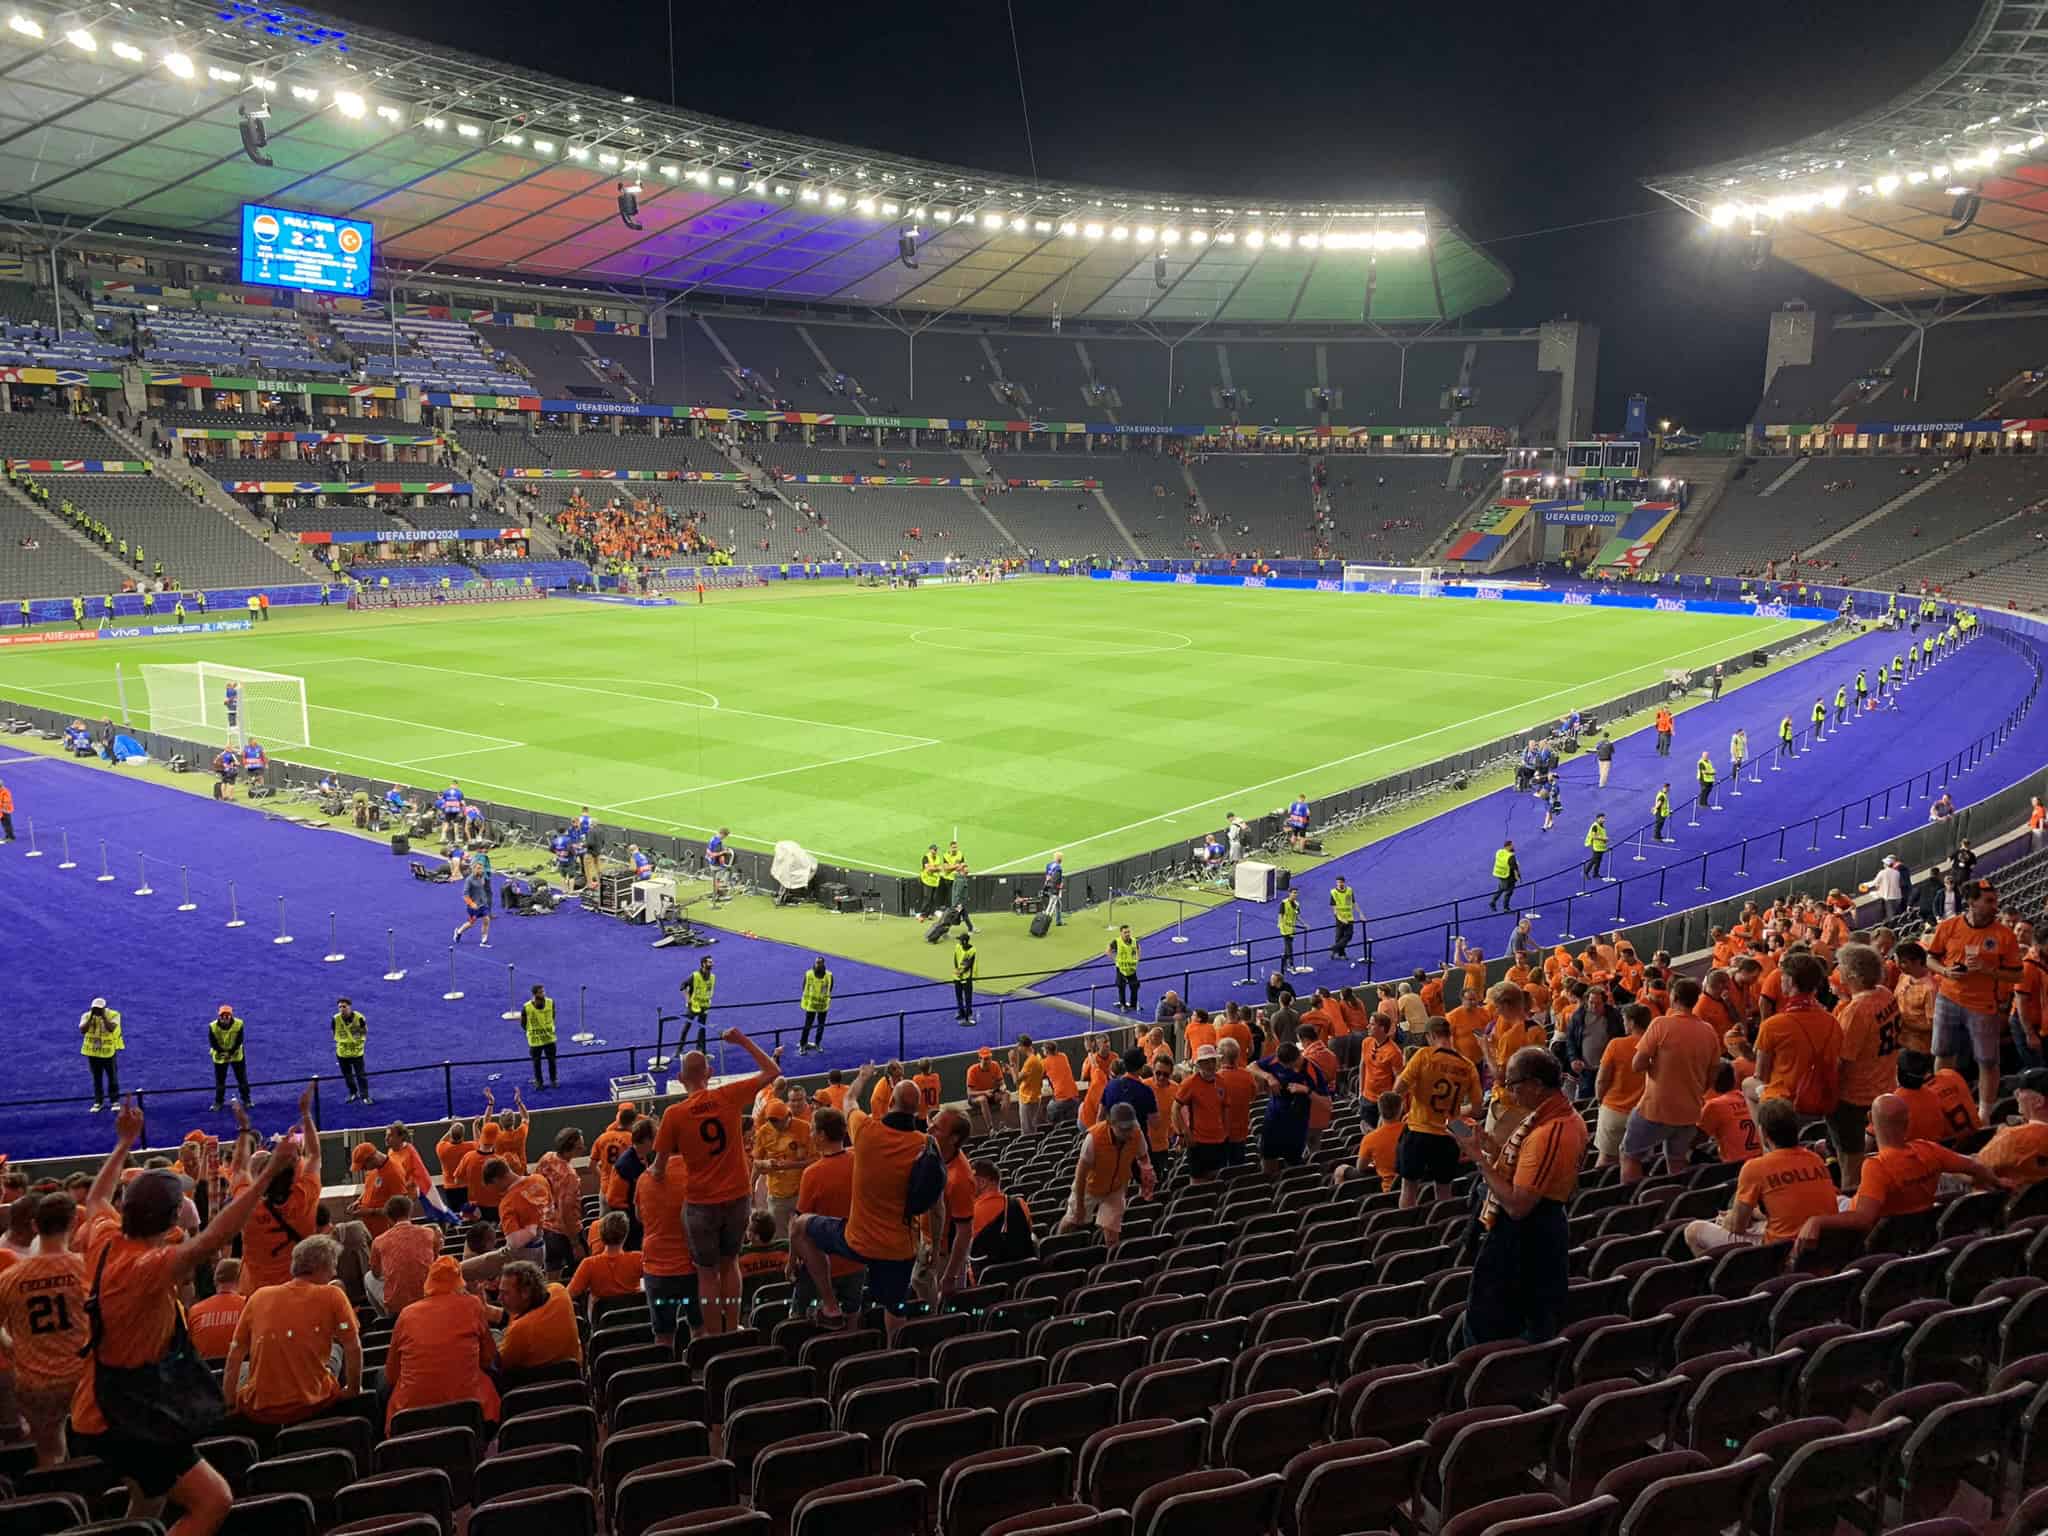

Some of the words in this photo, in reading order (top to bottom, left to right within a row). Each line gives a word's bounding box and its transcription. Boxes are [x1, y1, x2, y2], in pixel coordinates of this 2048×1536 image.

[1429, 1078, 1461, 1115] 21
[700, 1118, 726, 1155] 9
[28, 1294, 73, 1334] 21
